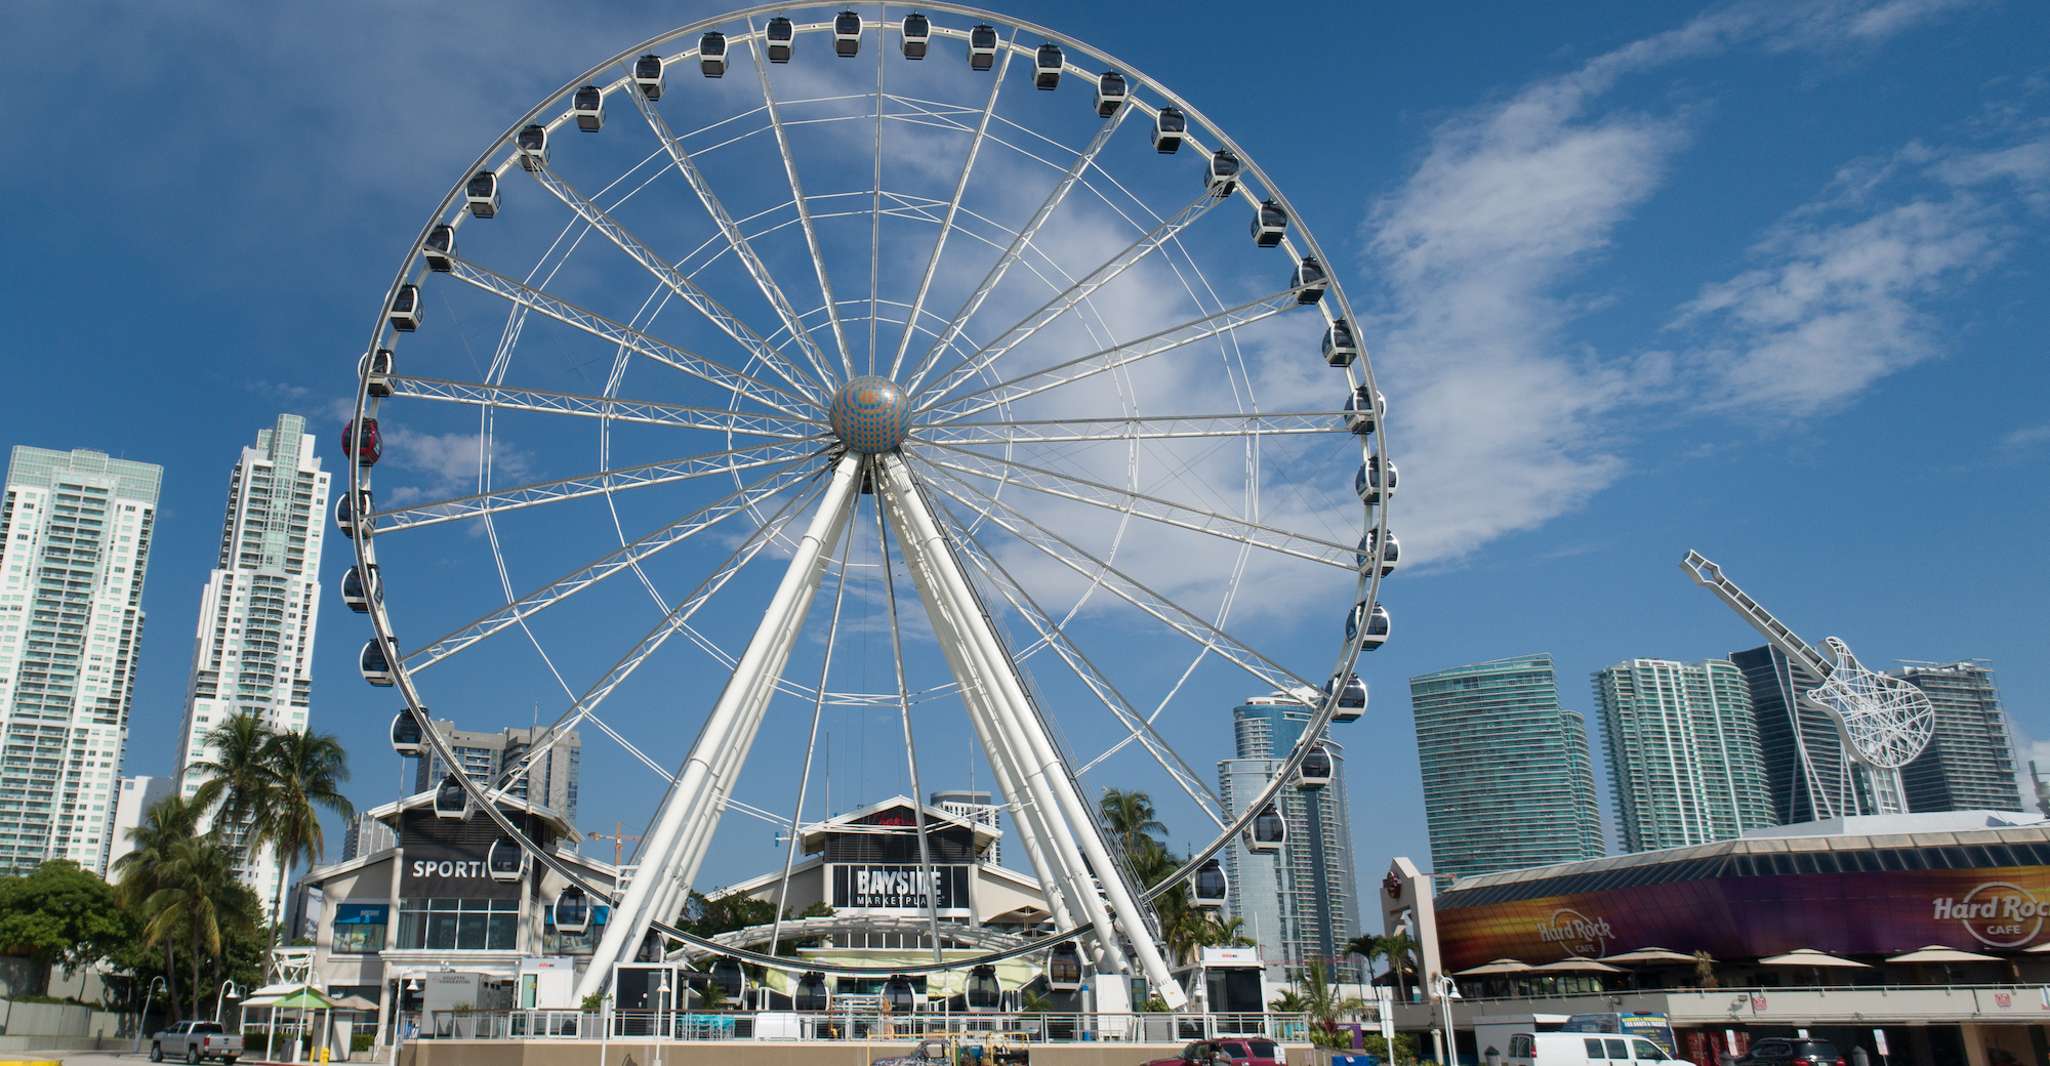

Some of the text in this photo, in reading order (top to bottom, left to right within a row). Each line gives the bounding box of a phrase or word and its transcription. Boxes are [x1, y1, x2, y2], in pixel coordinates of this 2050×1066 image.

[857, 870, 941, 895] BAYSIDE
[856, 895, 943, 905] MARKETPLAE
[1933, 895, 2050, 922] Hard Roc
[1536, 916, 1616, 942] Hard Rock
[1987, 924, 2022, 935] CAFE
[1575, 944, 1596, 953] CAFE
